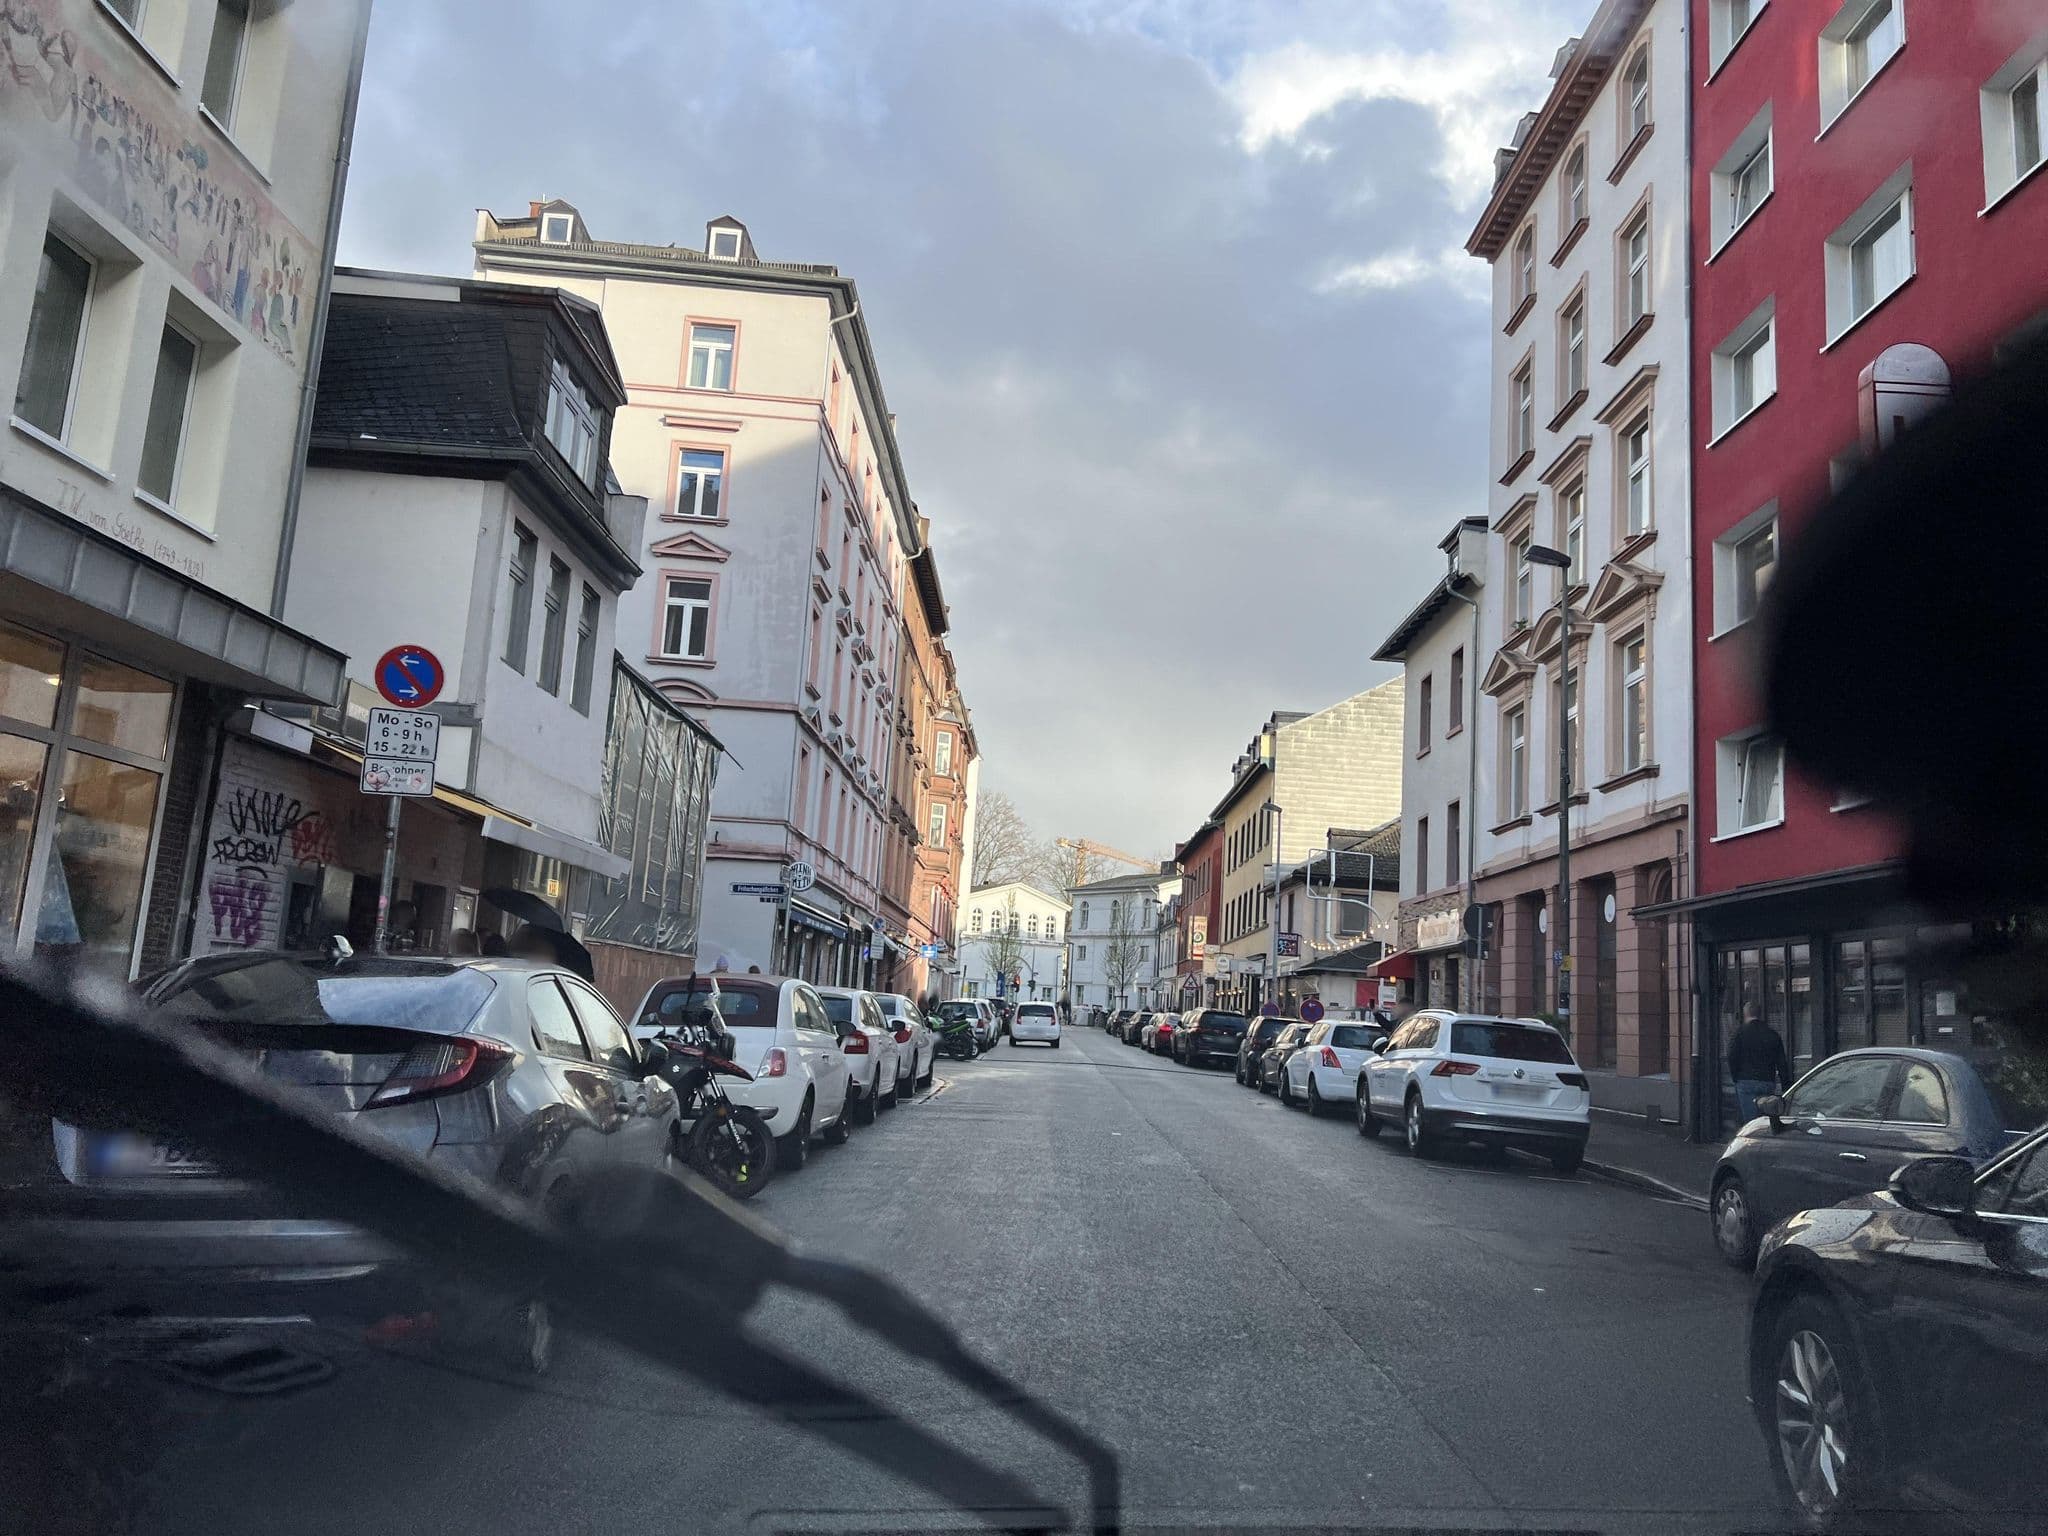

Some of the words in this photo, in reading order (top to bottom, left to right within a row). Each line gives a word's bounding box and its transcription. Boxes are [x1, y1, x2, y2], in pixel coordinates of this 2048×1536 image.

[111, 512, 145, 551] Goethe
[377, 712, 400, 725] Mo
[413, 717, 433, 728] So
[382, 727, 389, 737] 6
[402, 729, 410, 740] 9
[414, 730, 422, 741] h
[373, 741, 389, 752] 15
[401, 743, 417, 755] 22
[421, 745, 430, 756] h
[371, 763, 426, 775] Bohner
